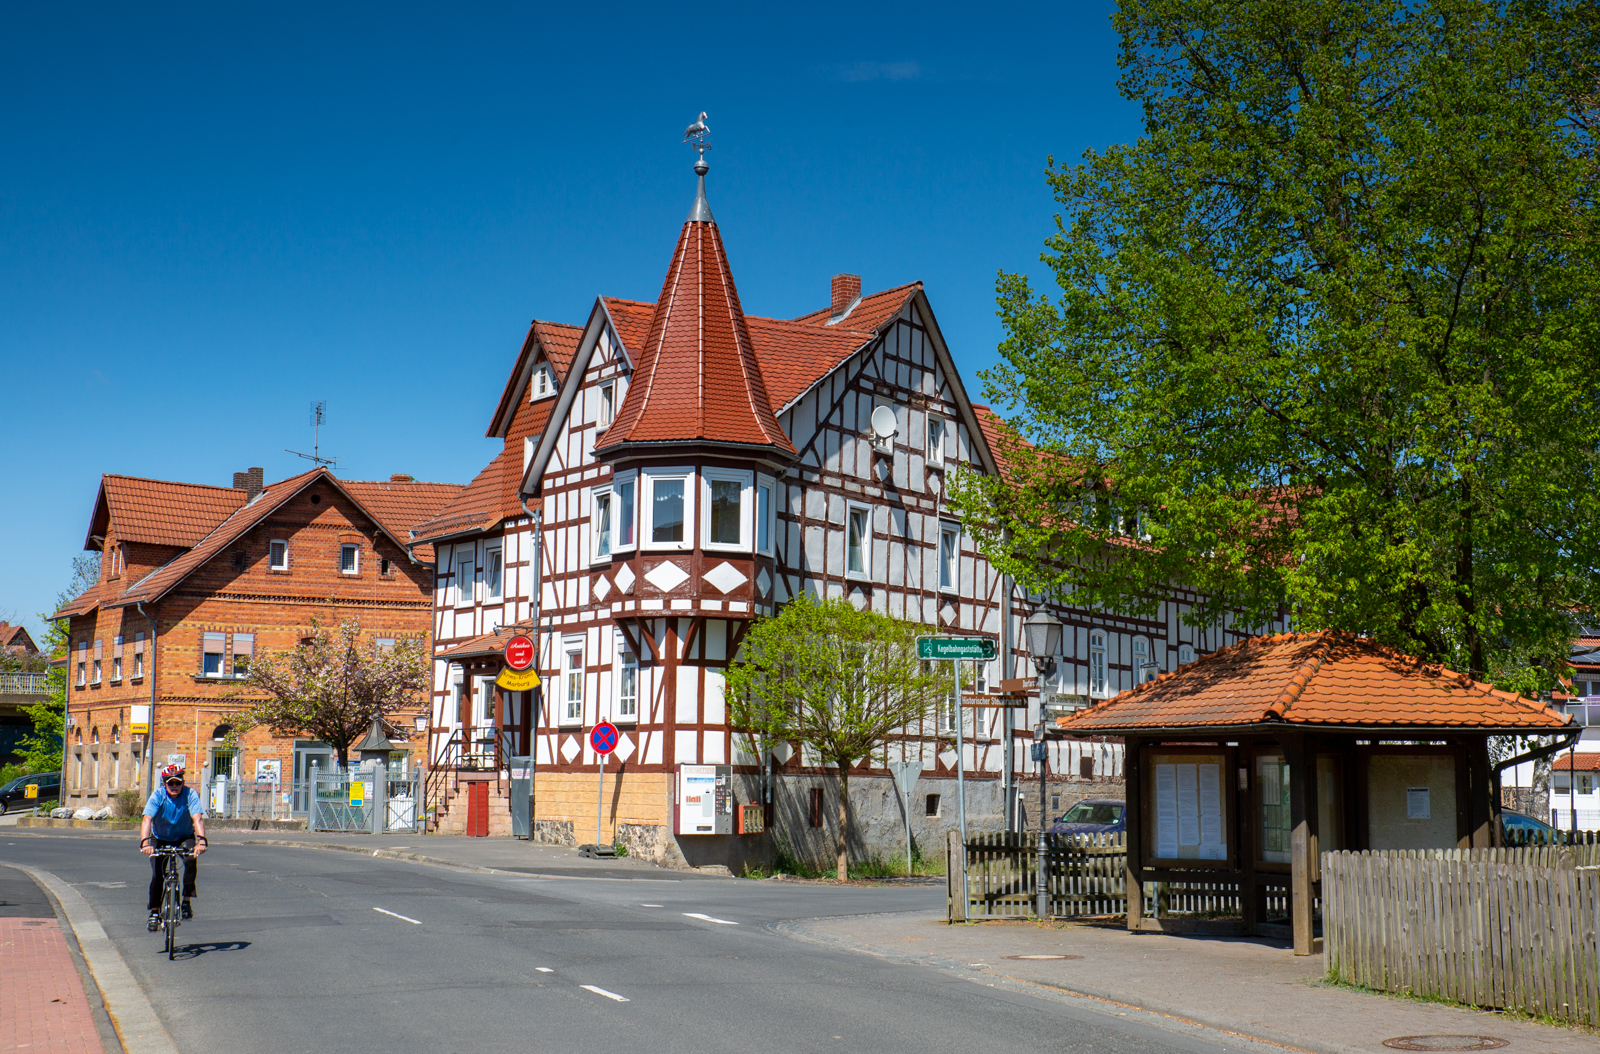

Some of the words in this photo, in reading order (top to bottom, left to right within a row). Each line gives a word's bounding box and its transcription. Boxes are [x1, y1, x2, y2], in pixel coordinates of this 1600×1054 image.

[937, 644, 983, 655] Kegelbahngaststätte
[506, 680, 530, 688] Marburg
[961, 696, 990, 705] Historischer
[686, 795, 701, 803] Hall
